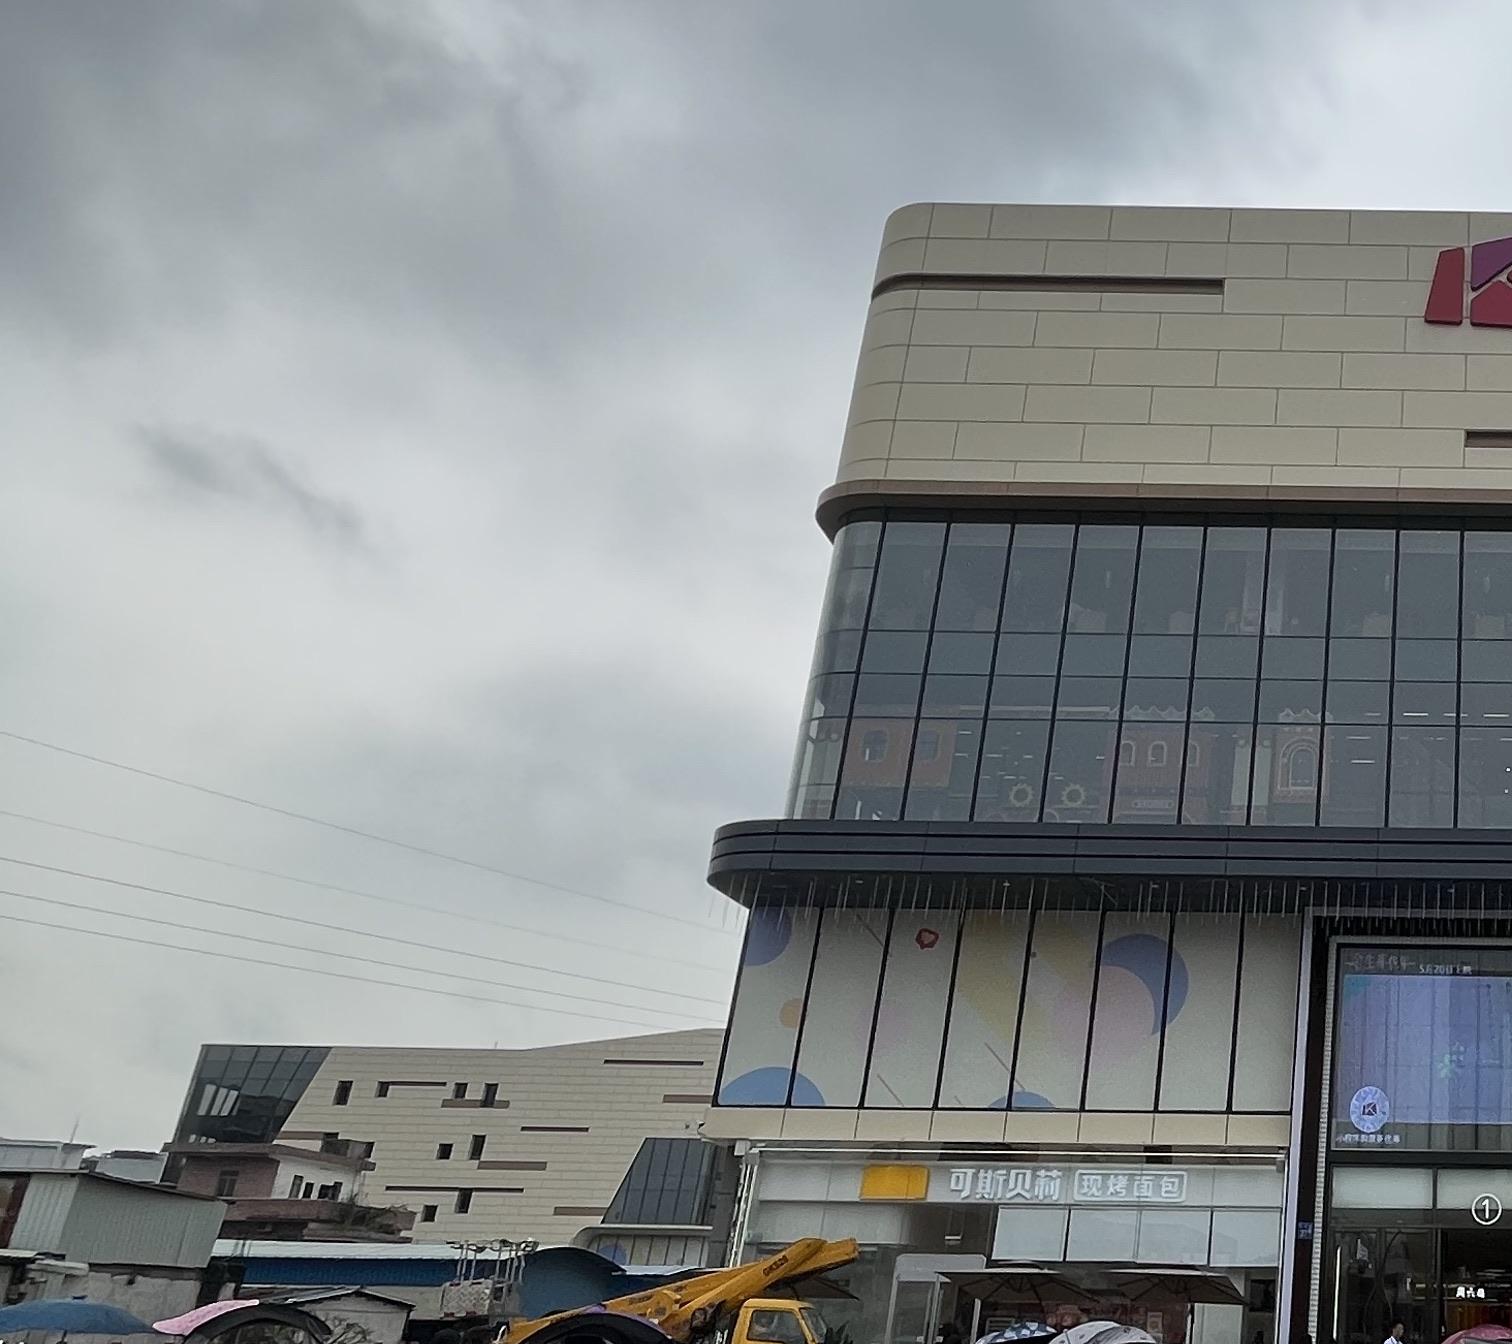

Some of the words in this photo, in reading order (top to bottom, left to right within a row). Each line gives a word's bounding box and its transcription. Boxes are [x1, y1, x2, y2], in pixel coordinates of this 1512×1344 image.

[950, 1168, 1063, 1201] 可斯贝莉
[1082, 1175, 1181, 1198] 现烤面包
